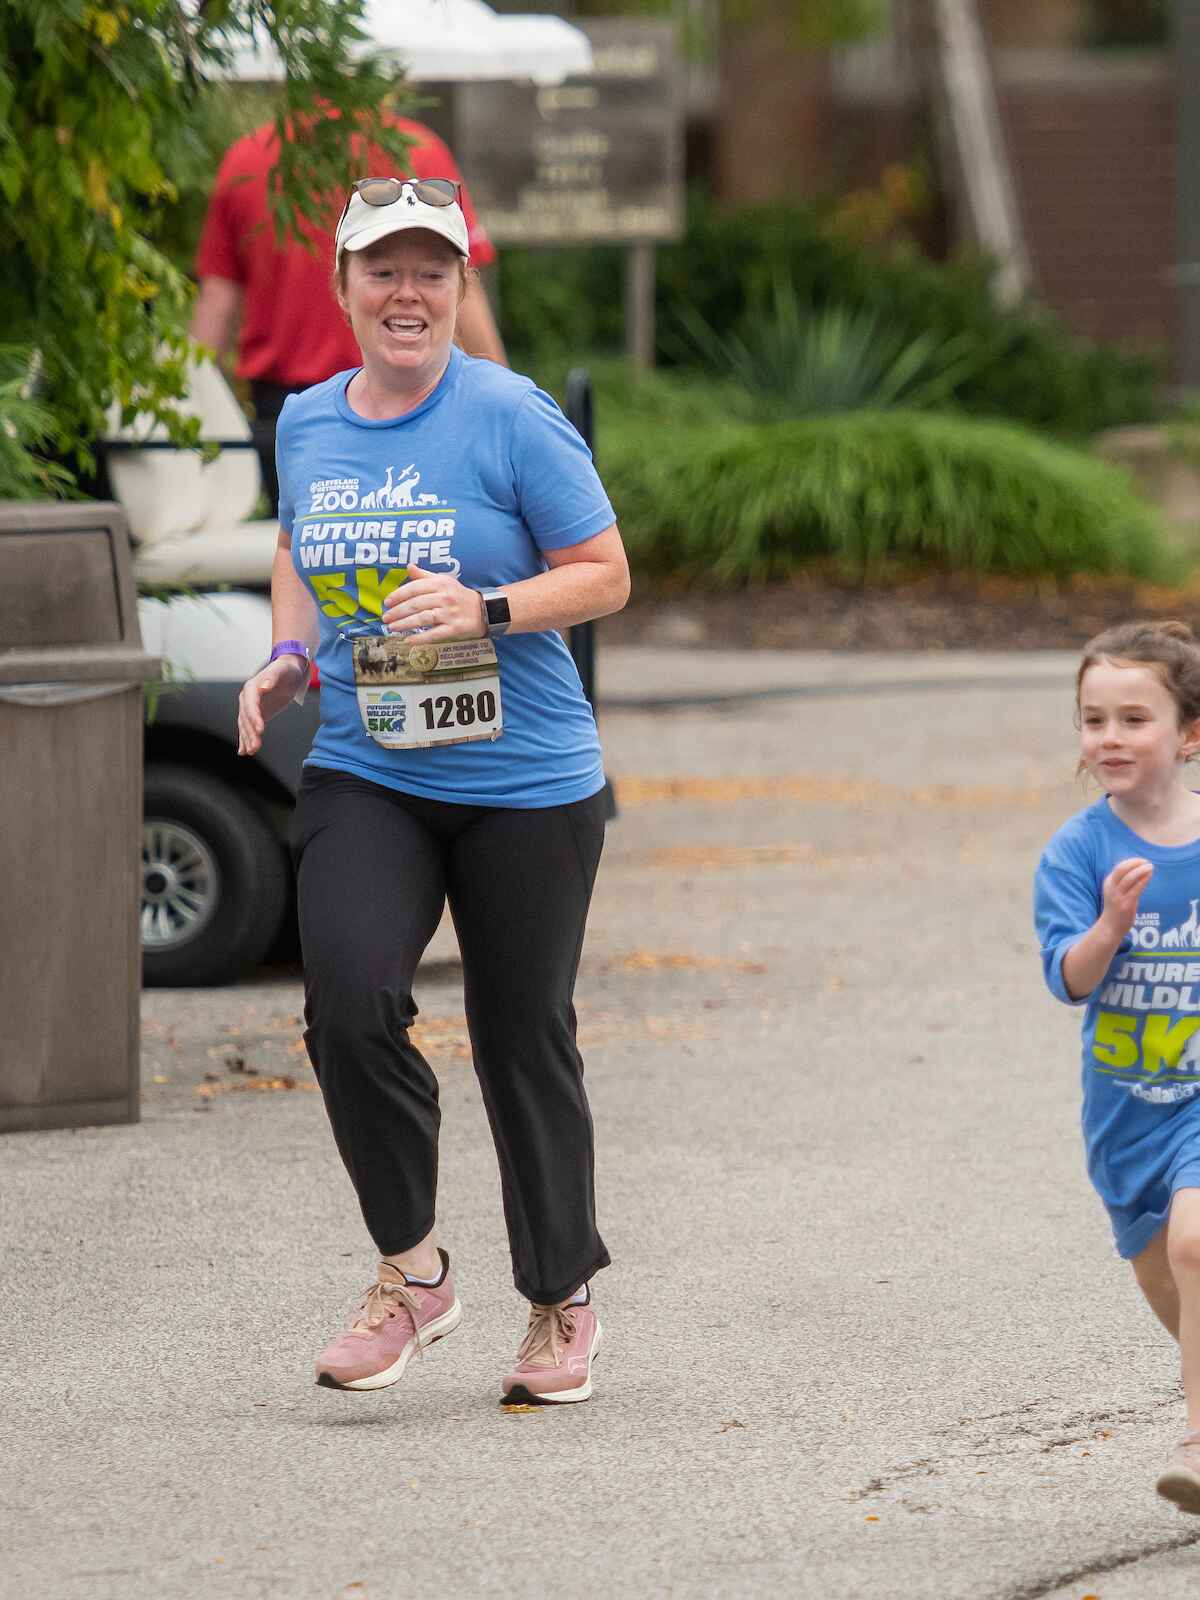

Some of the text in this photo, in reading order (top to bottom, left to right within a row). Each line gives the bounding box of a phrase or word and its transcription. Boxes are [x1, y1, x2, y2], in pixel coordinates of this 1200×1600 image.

[310, 490, 359, 512] ZOO
[301, 518, 455, 543] FUTURE FOR
[301, 540, 451, 568] WILDLIFE
[309, 568, 408, 618] 5K
[418, 690, 497, 730] 1280
[368, 717, 395, 732] 5K
